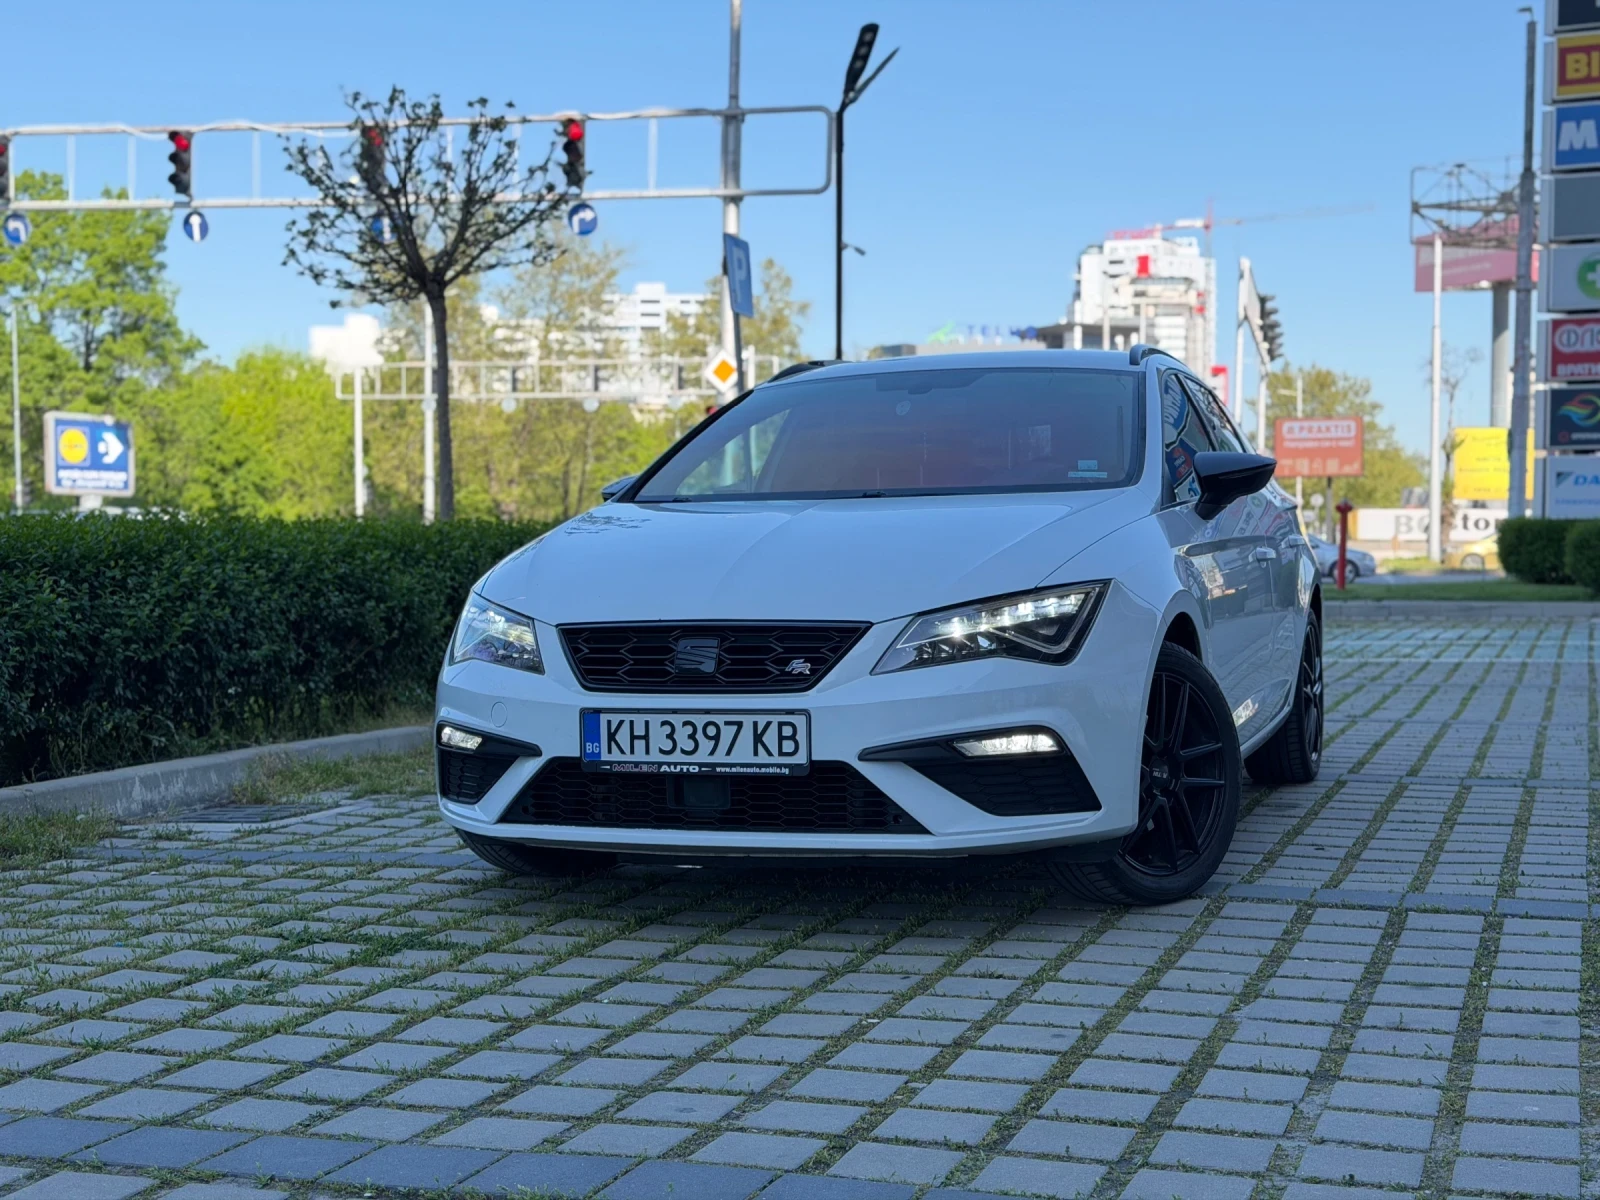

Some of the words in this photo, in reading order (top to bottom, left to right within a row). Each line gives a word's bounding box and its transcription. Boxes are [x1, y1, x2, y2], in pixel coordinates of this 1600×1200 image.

[733, 247, 748, 302] P
[785, 658, 811, 675] FR
[606, 719, 651, 756] KH
[658, 720, 744, 757] 3397
[752, 720, 800, 757] KB
[586, 742, 600, 753] BG
[612, 763, 658, 772] MILEN
[660, 765, 699, 773] AUTO
